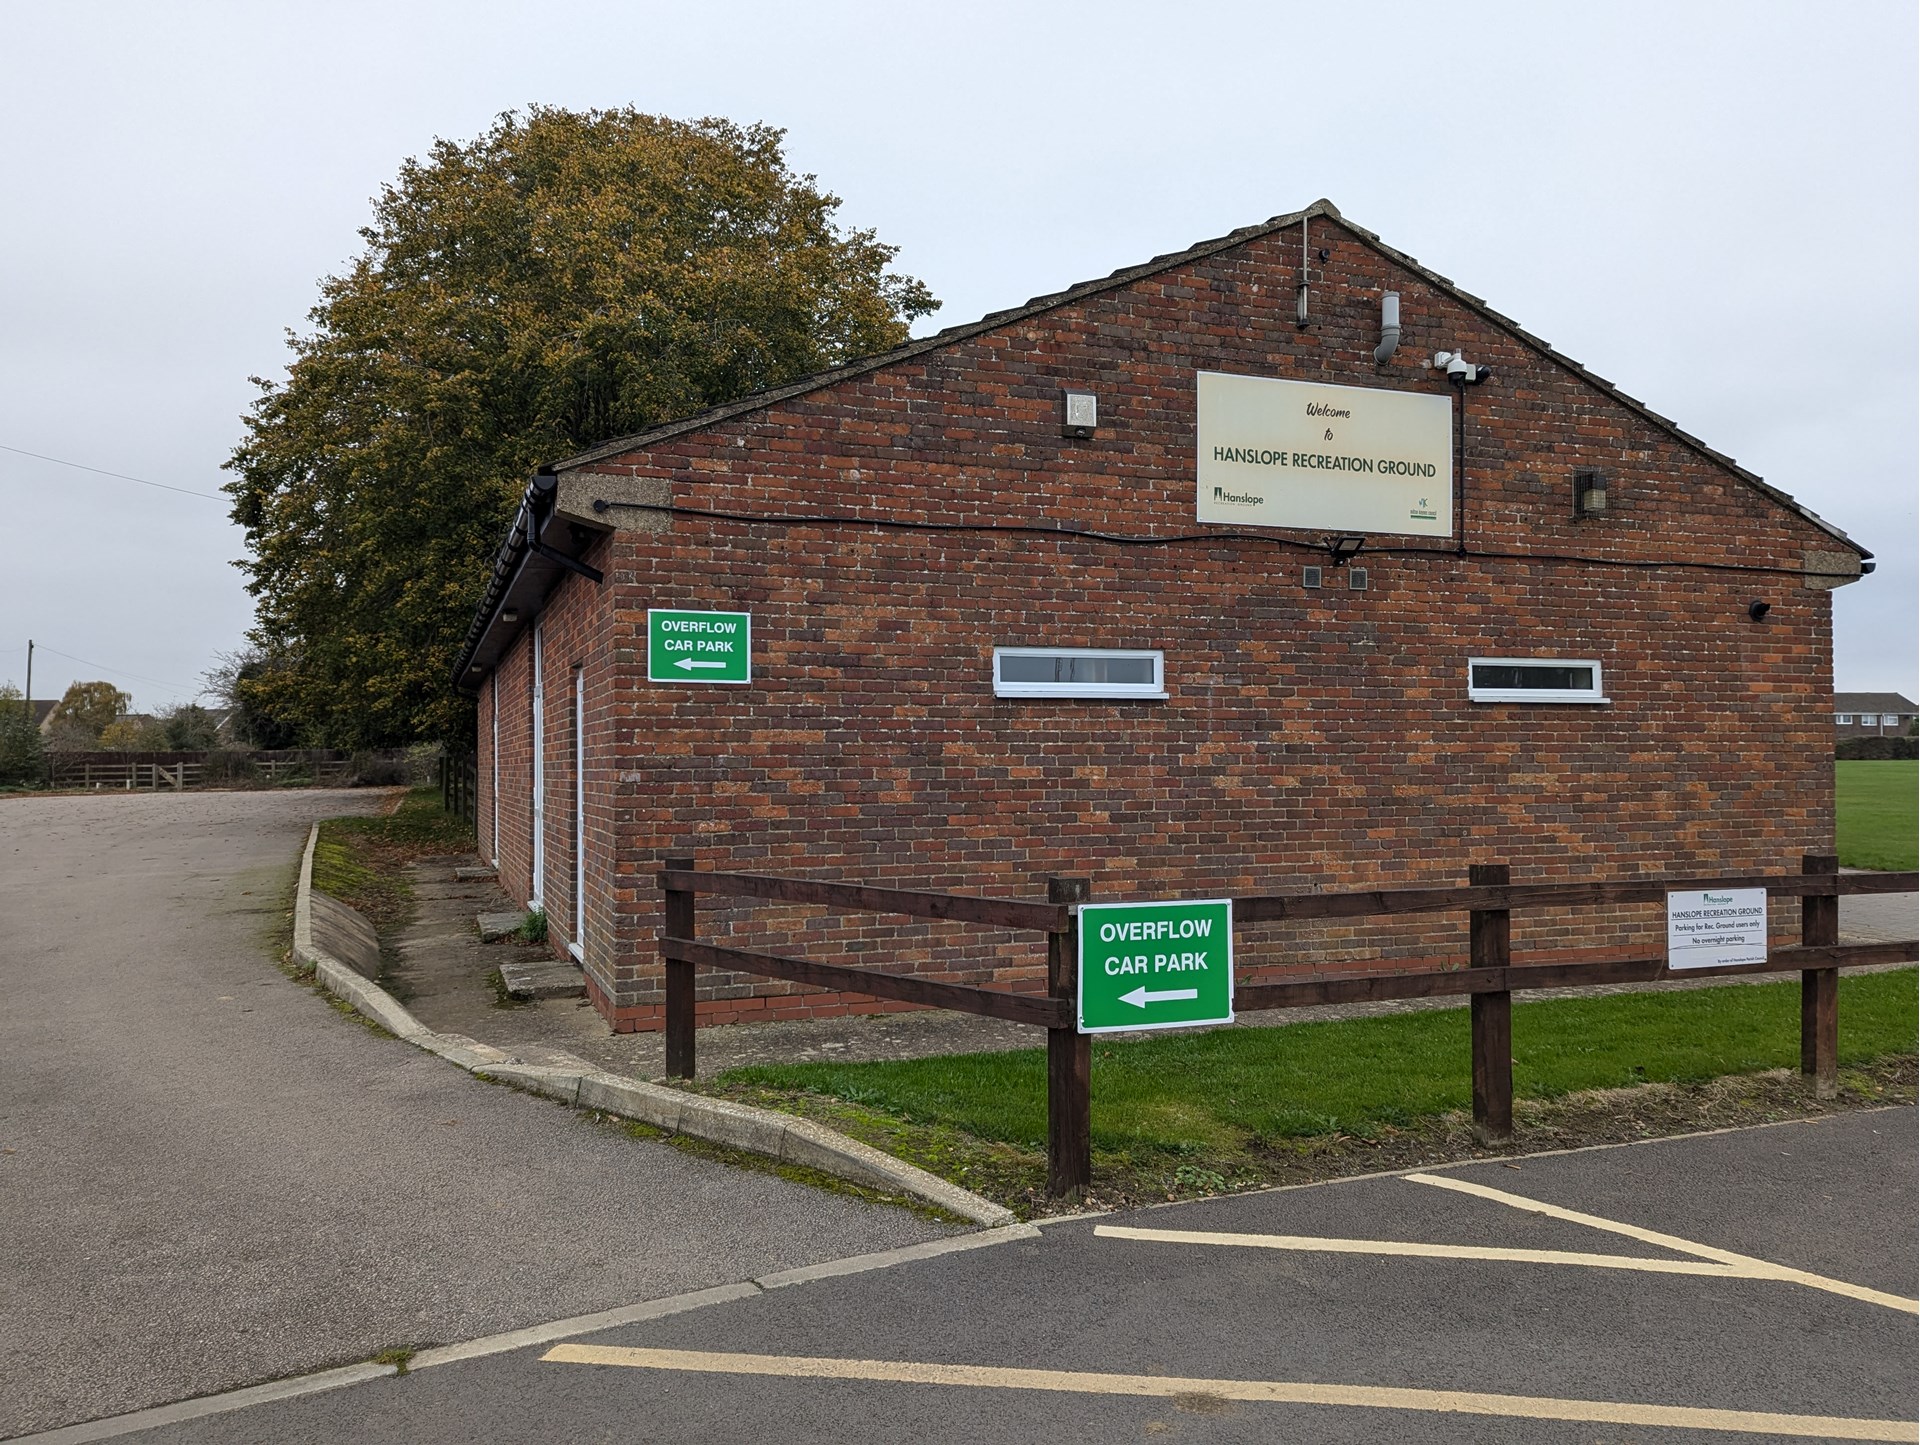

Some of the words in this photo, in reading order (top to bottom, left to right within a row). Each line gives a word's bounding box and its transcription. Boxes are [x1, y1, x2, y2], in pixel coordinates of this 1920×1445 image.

[1306, 402, 1351, 419] Welcome
[1323, 427, 1334, 441] to
[1214, 446, 1288, 466] HANSLOPE
[1292, 452, 1374, 473] RECREATION
[1377, 459, 1436, 478] GROUND
[1223, 492, 1264, 506] Hanslope
[661, 620, 737, 634] OVERFLOW
[664, 639, 693, 651] CAR
[697, 640, 734, 652] PARK
[1709, 895, 1733, 904] Hanslope
[1672, 910, 1702, 918] HANSLOPE
[1704, 908, 1737, 917] RECREATION
[1738, 907, 1762, 915] GROUND
[1100, 918, 1213, 943] OVERFLOW
[1675, 923, 1695, 932] Parking
[1716, 921, 1735, 929] Ground
[1750, 920, 1760, 928] only
[1701, 936, 1725, 944] overnight
[1726, 934, 1745, 944] parking
[1104, 955, 1148, 976] CAR
[1154, 952, 1209, 973] PARK
